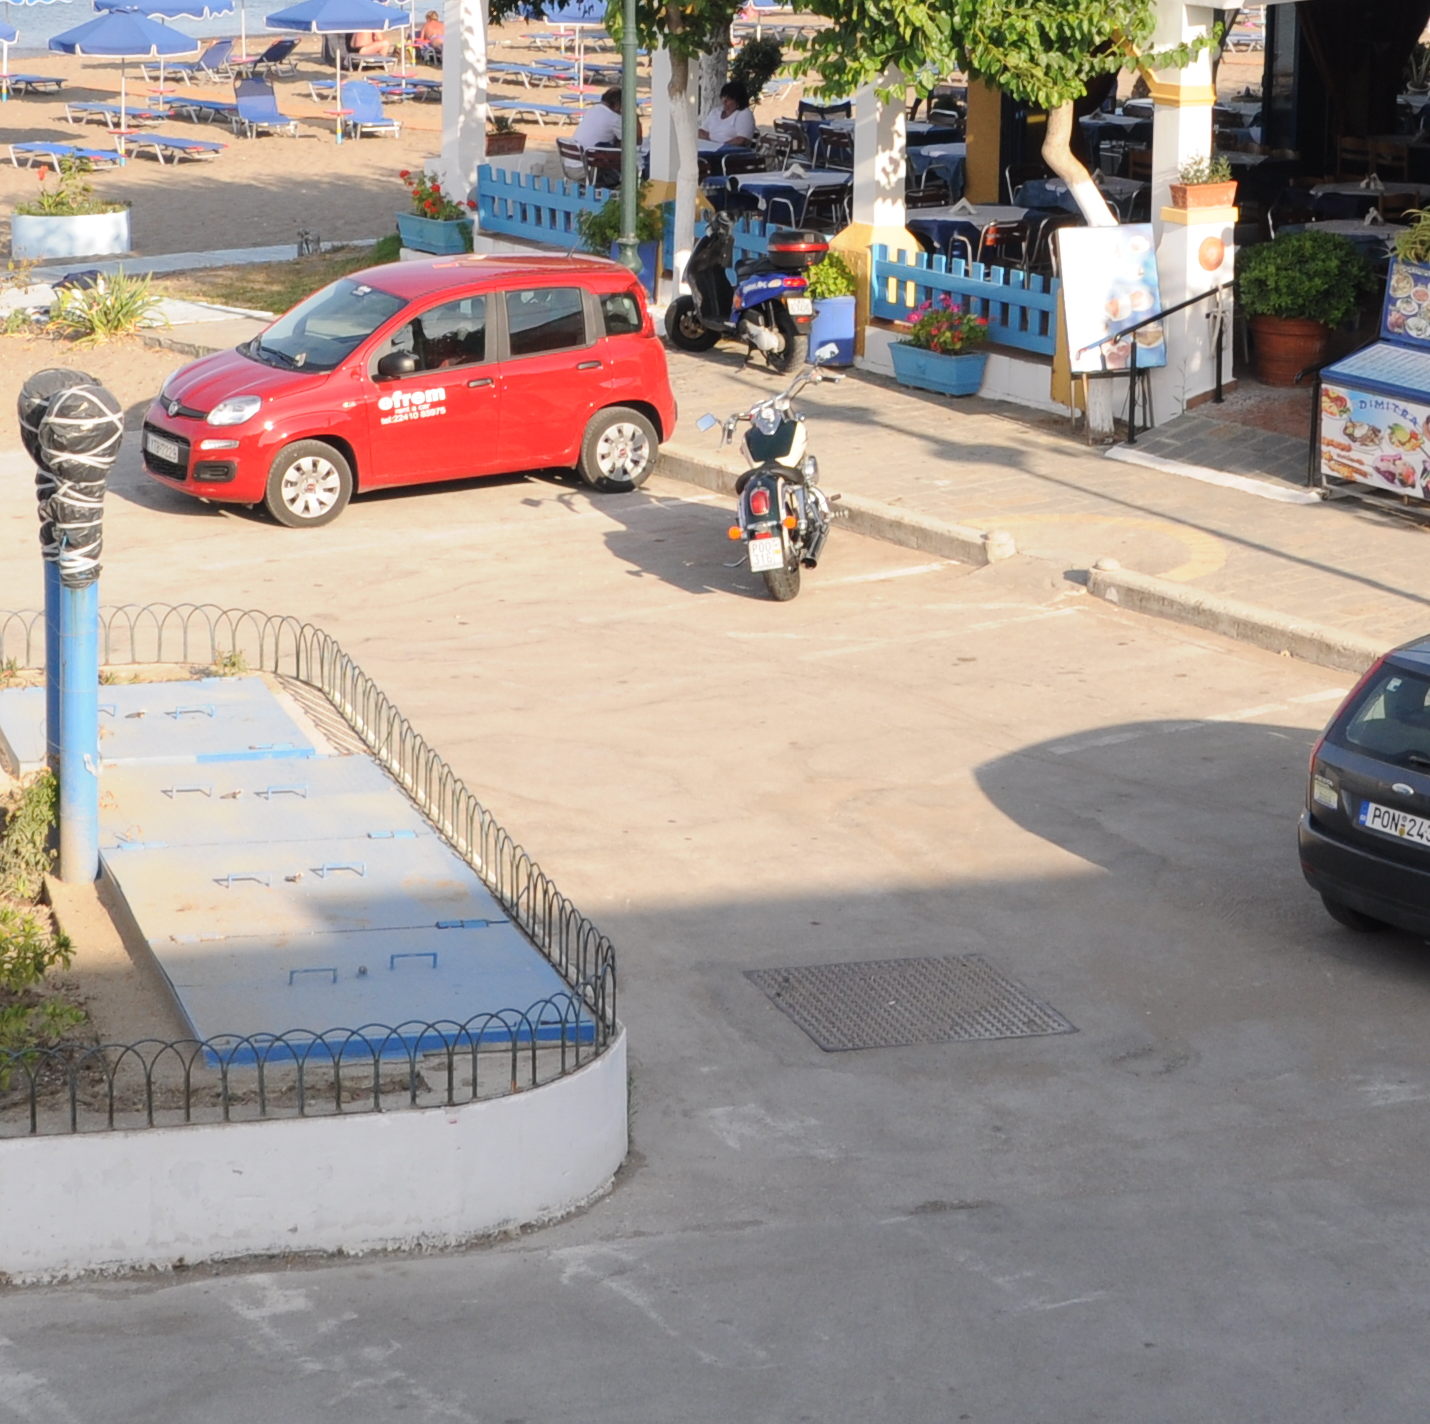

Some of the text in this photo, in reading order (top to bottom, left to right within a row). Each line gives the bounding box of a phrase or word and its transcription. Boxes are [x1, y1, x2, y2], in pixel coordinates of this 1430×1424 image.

[377, 387, 447, 411] efrem
[1358, 399, 1419, 427] DIMITRA
[753, 552, 773, 565] 316
